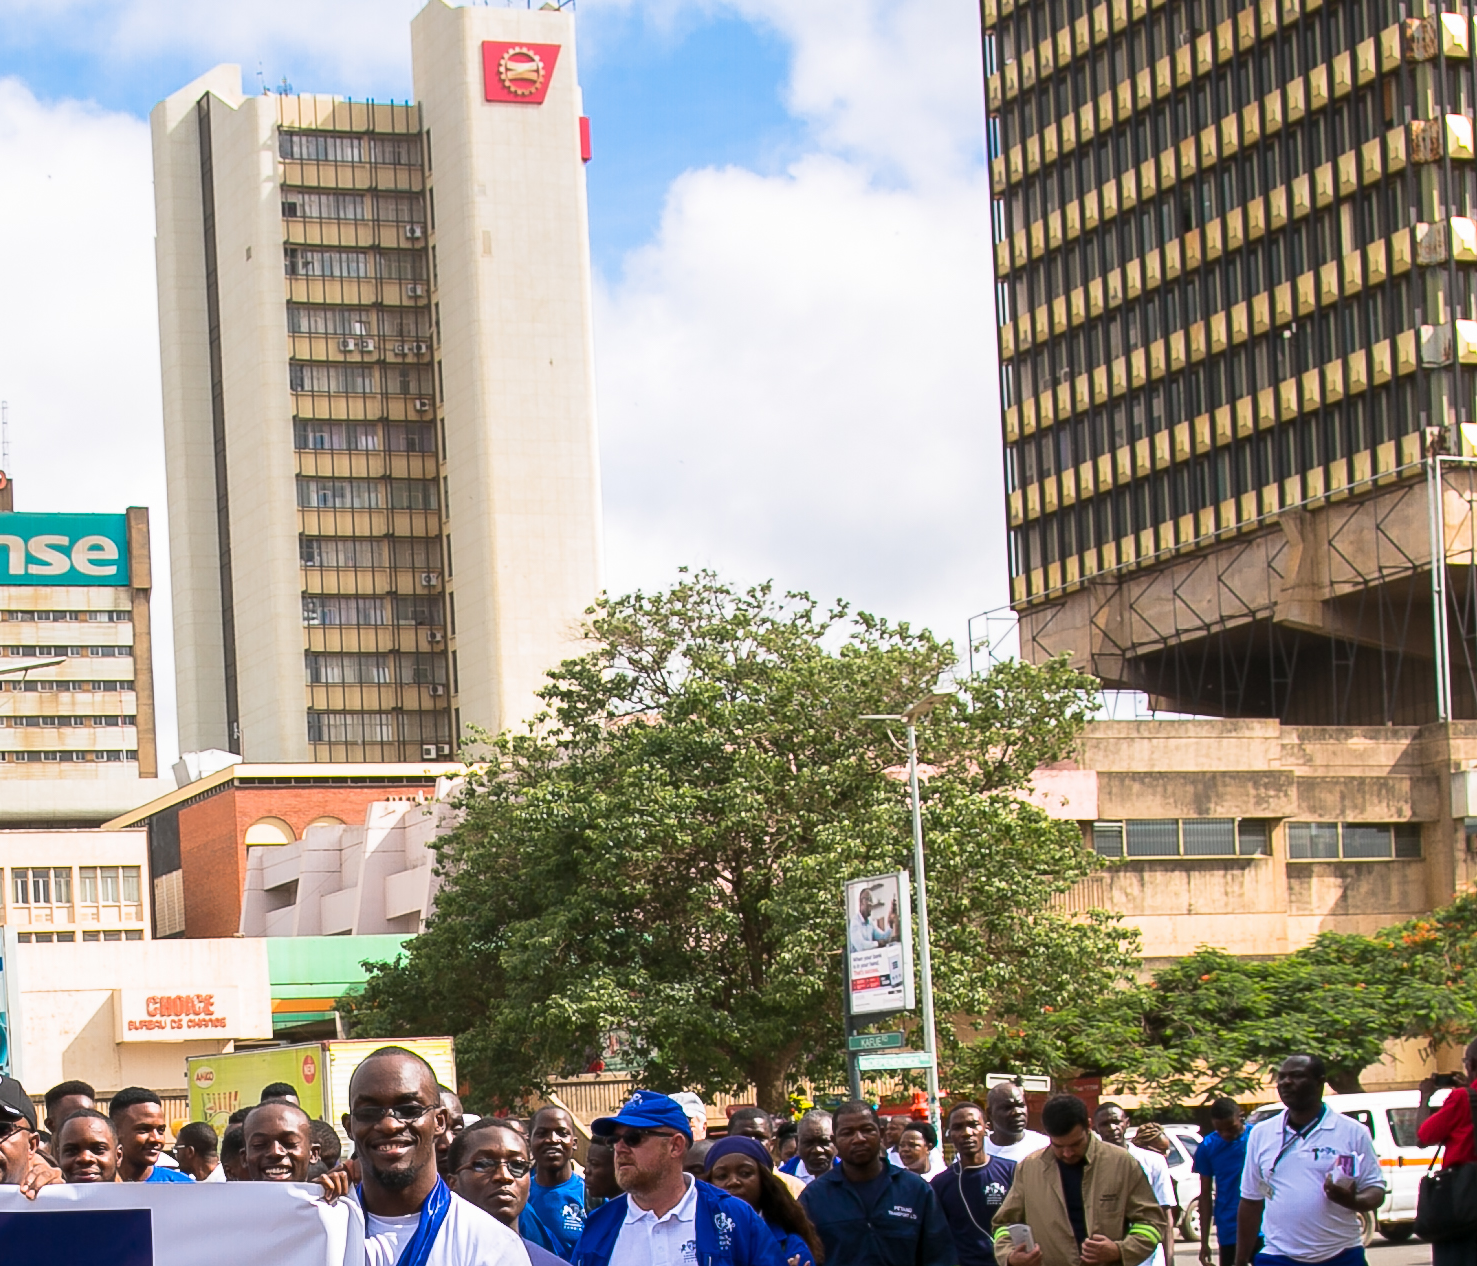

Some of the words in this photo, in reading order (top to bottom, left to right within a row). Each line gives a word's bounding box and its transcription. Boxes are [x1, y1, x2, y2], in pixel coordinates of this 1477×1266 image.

[146, 994, 215, 1017] CHOICE
[127, 1019, 167, 1031] BUREAU
[861, 1037, 882, 1048] KAFUE
